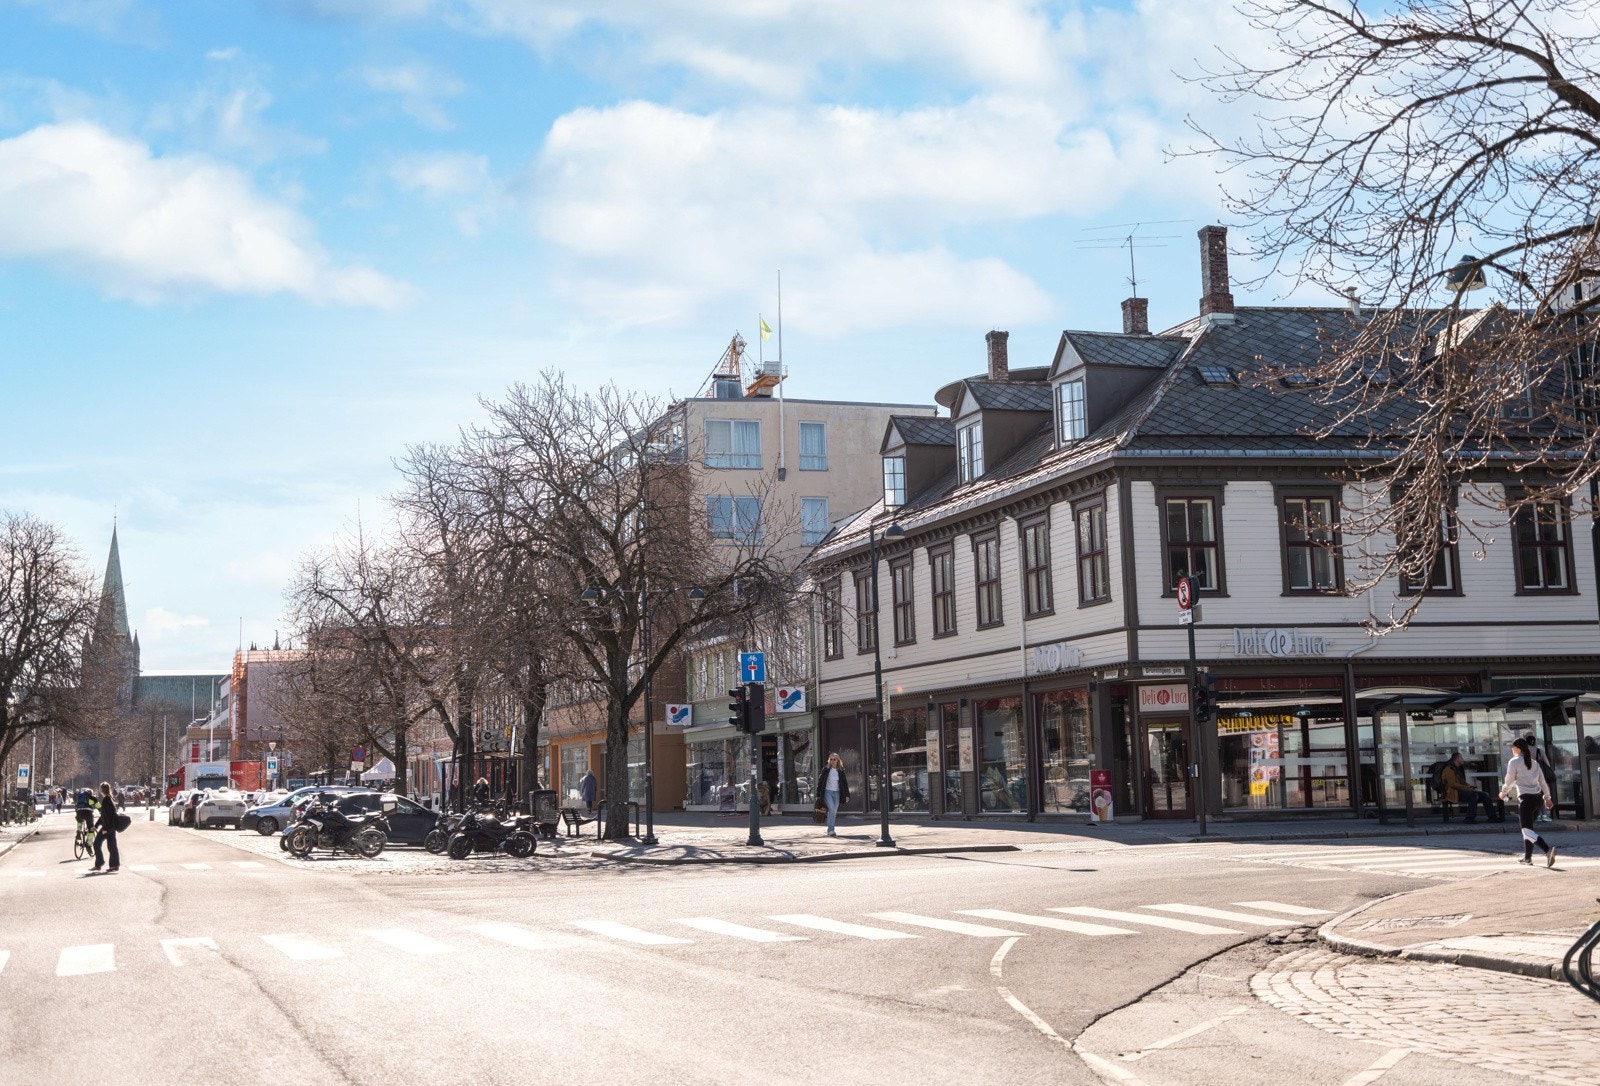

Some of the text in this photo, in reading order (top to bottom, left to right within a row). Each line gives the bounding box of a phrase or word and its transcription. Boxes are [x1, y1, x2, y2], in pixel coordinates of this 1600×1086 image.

[1233, 626, 1327, 656] Deli de Luca
[1141, 689, 1156, 705] Deli
[1171, 688, 1187, 704] Luca
